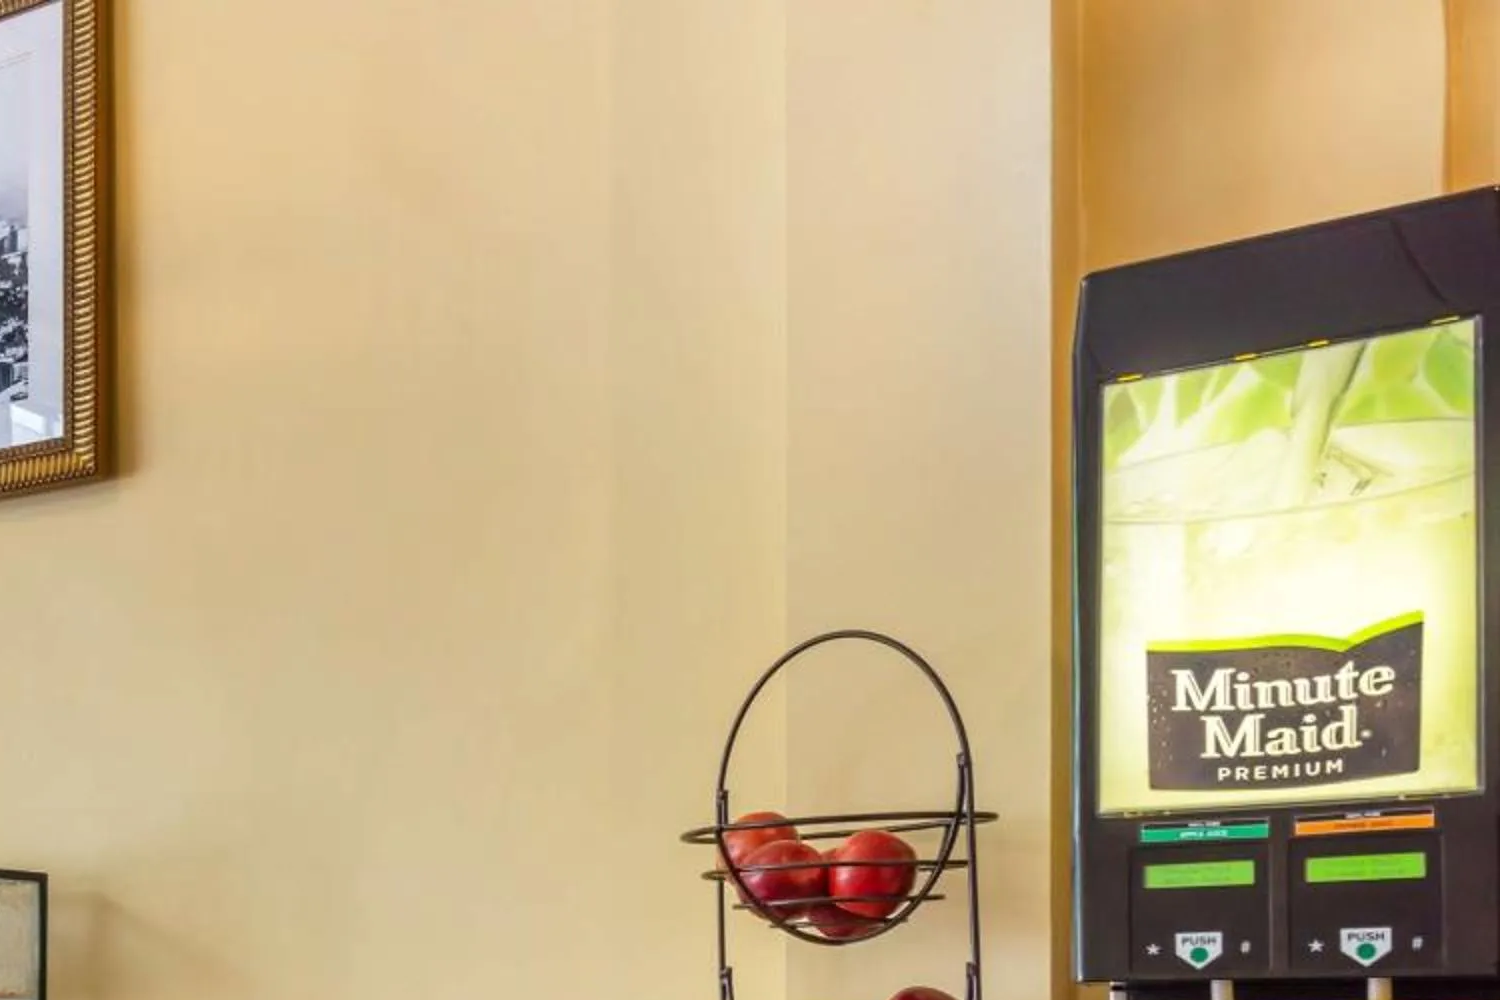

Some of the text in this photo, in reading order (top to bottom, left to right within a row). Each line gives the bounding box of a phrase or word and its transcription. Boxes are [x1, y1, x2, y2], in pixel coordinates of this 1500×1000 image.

[1171, 660, 1396, 712] Minute
[1200, 705, 1363, 759] Maid
[1217, 758, 1344, 782] PREMIUM
[1181, 935, 1217, 946] PUSH
[1347, 931, 1385, 942] PUSH
